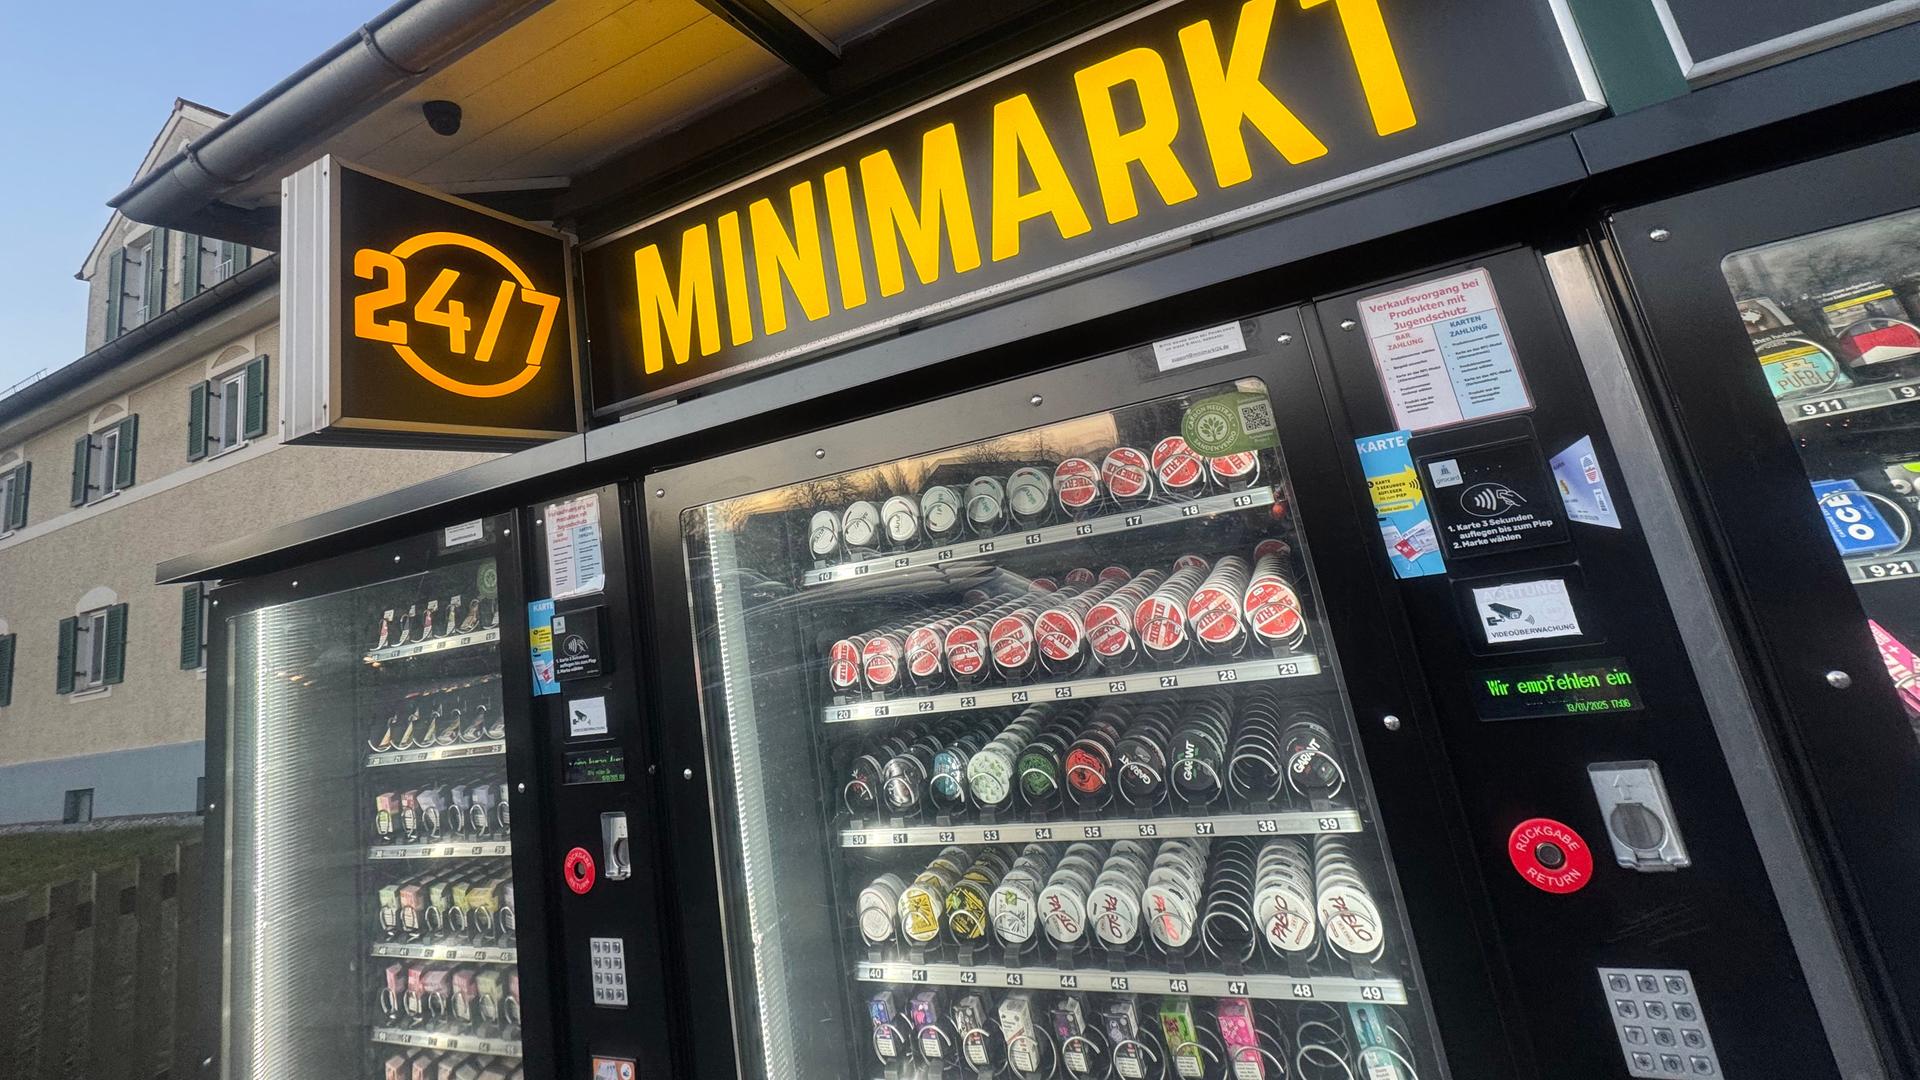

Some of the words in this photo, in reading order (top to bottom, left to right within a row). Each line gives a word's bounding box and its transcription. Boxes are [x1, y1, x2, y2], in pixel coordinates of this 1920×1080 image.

[633, 0, 1418, 376] MINIMARKT
[354, 248, 561, 366] 24/7
[1369, 284, 1460, 313] Verkaufsvorgang
[1461, 278, 1480, 290] bei
[1389, 301, 1445, 320] Produkten
[1447, 294, 1466, 306] mit
[1393, 306, 1468, 330] Jugendschutz
[1449, 314, 1482, 328] KARTEN
[1449, 323, 1488, 337] ZAHLUNG
[1388, 338, 1424, 351] ZAHLUNG
[1900, 386, 1920, 398] 9
[1187, 404, 1206, 430] CARBON
[1206, 404, 1235, 422] NEUTRAL
[1802, 399, 1843, 415] 911
[1356, 436, 1406, 454] KARTE
[940, 551, 952, 560] 13
[980, 543, 993, 552] 14
[1027, 534, 1040, 543] 15
[1078, 525, 1091, 534] 16
[1126, 516, 1140, 525] 17
[1184, 505, 1198, 516] 18
[1235, 496, 1251, 506] 19
[1456, 521, 1482, 531] Karte
[1488, 514, 1534, 526] Sekunden
[1459, 528, 1498, 540] auflegen
[1499, 525, 1512, 533] bis
[1513, 522, 1533, 531] zum
[1532, 519, 1554, 529] Piep
[1462, 538, 1489, 548] Marke
[1489, 533, 1522, 544] wählen
[1869, 561, 1914, 577] 921
[1491, 623, 1576, 638] VIDEOÜBERWACHUNG
[838, 711, 849, 719] 20
[876, 706, 888, 715] 21
[920, 702, 932, 710] 22
[962, 697, 975, 707] 23
[1013, 692, 1026, 702] 24
[1057, 688, 1070, 697] 25
[1110, 682, 1125, 692] 26
[1161, 676, 1176, 686] 27
[1219, 670, 1236, 681] 28
[1279, 664, 1296, 674] 29
[1486, 679, 1509, 697] Wir
[1517, 672, 1601, 695] empfehlen
[1606, 668, 1632, 686] ein
[1293, 737, 1321, 774] GARANT
[853, 835, 864, 844] 30
[893, 834, 905, 843] 31
[940, 832, 953, 842] 32
[984, 831, 997, 841] 33
[1036, 829, 1050, 839] 34
[1085, 827, 1099, 837] 35
[1140, 825, 1155, 835] 36
[1196, 823, 1212, 834] 37
[1258, 820, 1275, 832] 38
[1320, 818, 1338, 830] 39
[1515, 824, 1580, 852] RÜCKGABE
[1526, 866, 1582, 888] RETURN
[869, 969, 882, 978] 40
[912, 970, 925, 980] 41
[961, 972, 975, 983] 42
[1007, 974, 1021, 985] 43
[1060, 976, 1076, 987] 44
[1111, 978, 1126, 989] 45
[1170, 980, 1187, 992] 46
[1229, 982, 1246, 994] 47
[1293, 984, 1311, 997] 48
[1362, 986, 1381, 1000] 49
